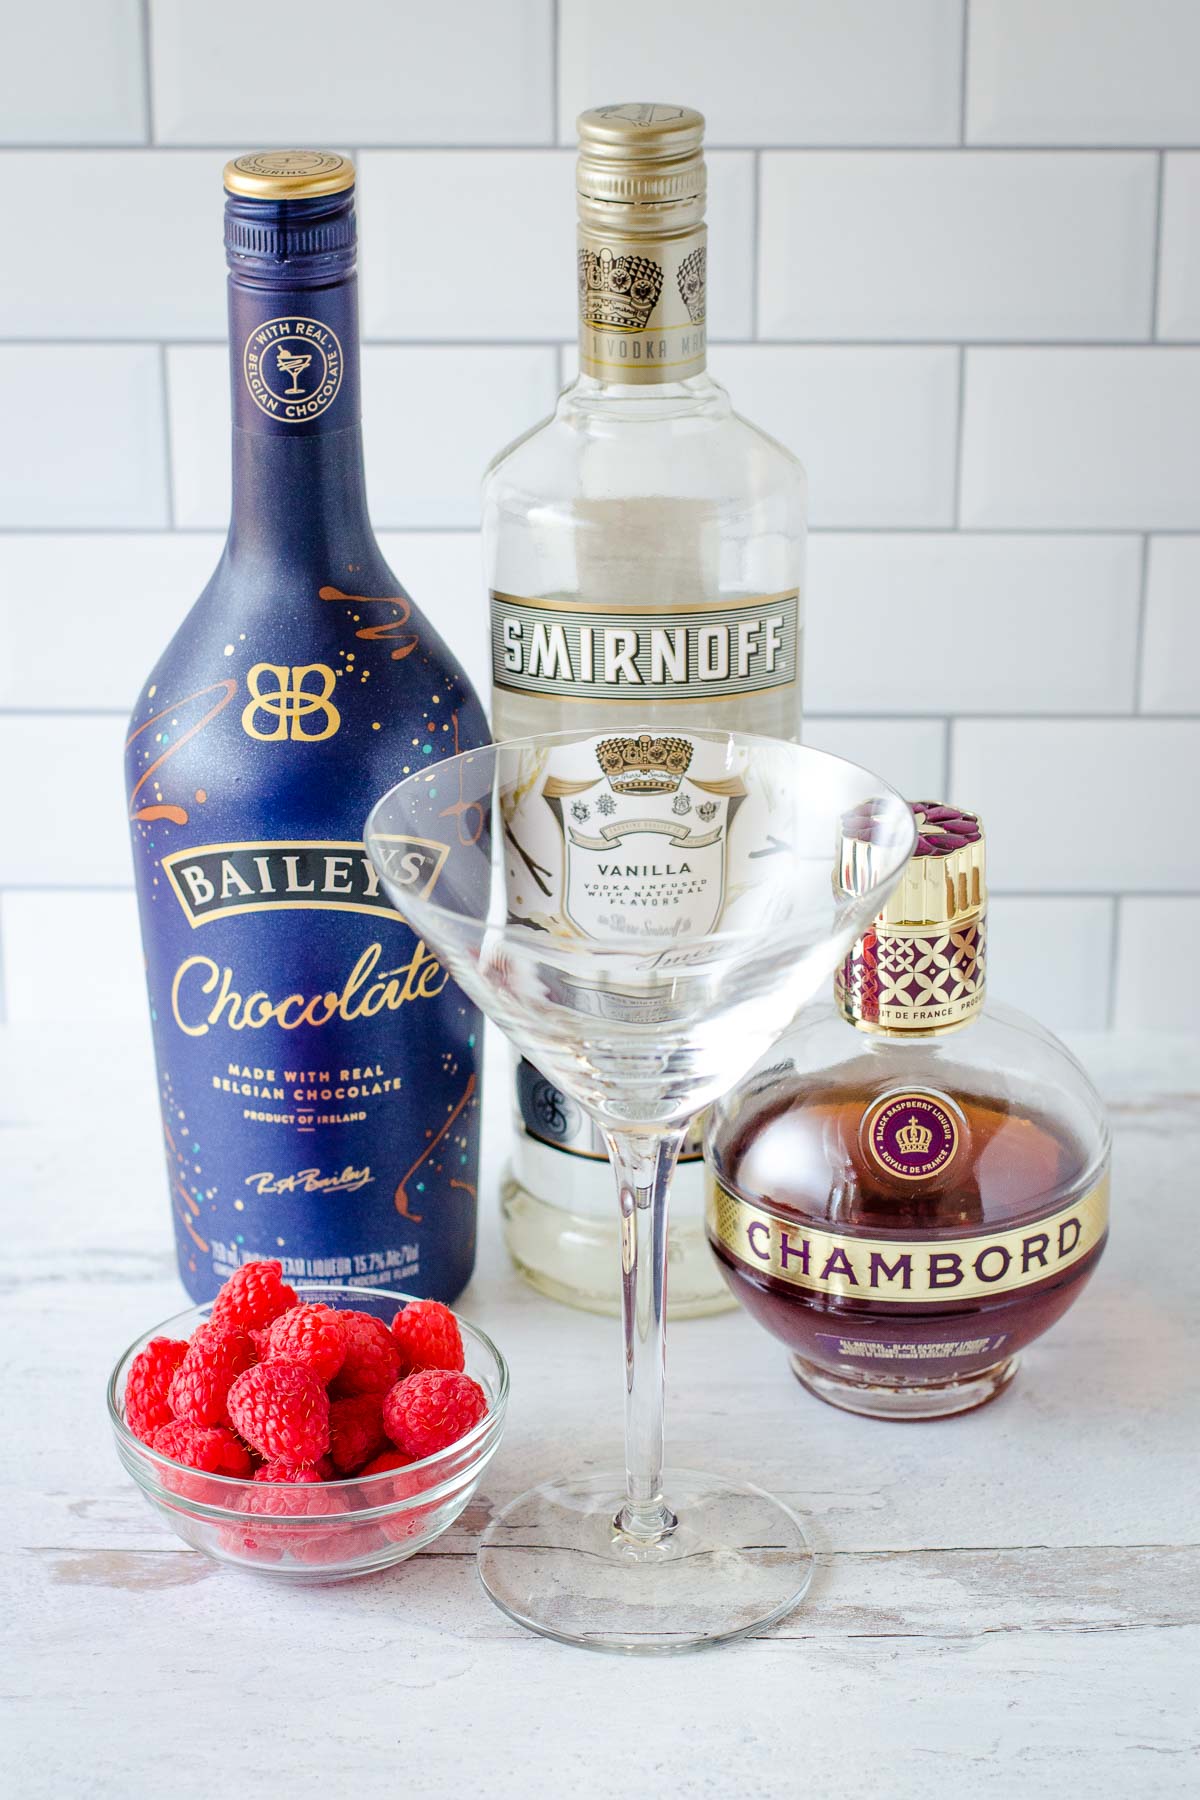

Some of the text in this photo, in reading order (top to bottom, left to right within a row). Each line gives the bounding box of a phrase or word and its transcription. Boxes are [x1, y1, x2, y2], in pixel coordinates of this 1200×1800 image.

[255, 322, 328, 345] WITH REAL
[607, 338, 667, 359] VODKA
[248, 350, 339, 417] BELGIAN CHOCOLATE
[502, 615, 785, 686] SMIRNOFF
[181, 848, 426, 906] BAILEYS
[597, 862, 692, 877] VANILLA
[584, 879, 707, 891] VODKA INFUSED
[634, 886, 703, 898] NATURAL
[610, 896, 680, 907] FLAVORS
[171, 939, 449, 1037] Chocolate
[895, 1011, 909, 1020] DE
[913, 1007, 953, 1020] FRANCE
[228, 1062, 384, 1083] MADE WITH REAL
[212, 1076, 402, 1101] BELGIAN CHOCOLATE
[243, 1109, 367, 1125] PRODUCT OF IRELAND
[876, 1101, 952, 1141] BLACK RASPBERRY LIQUEUR
[881, 1149, 948, 1174] ROYALE DE FRANCE
[745, 1216, 1083, 1290] CHAMBORD
